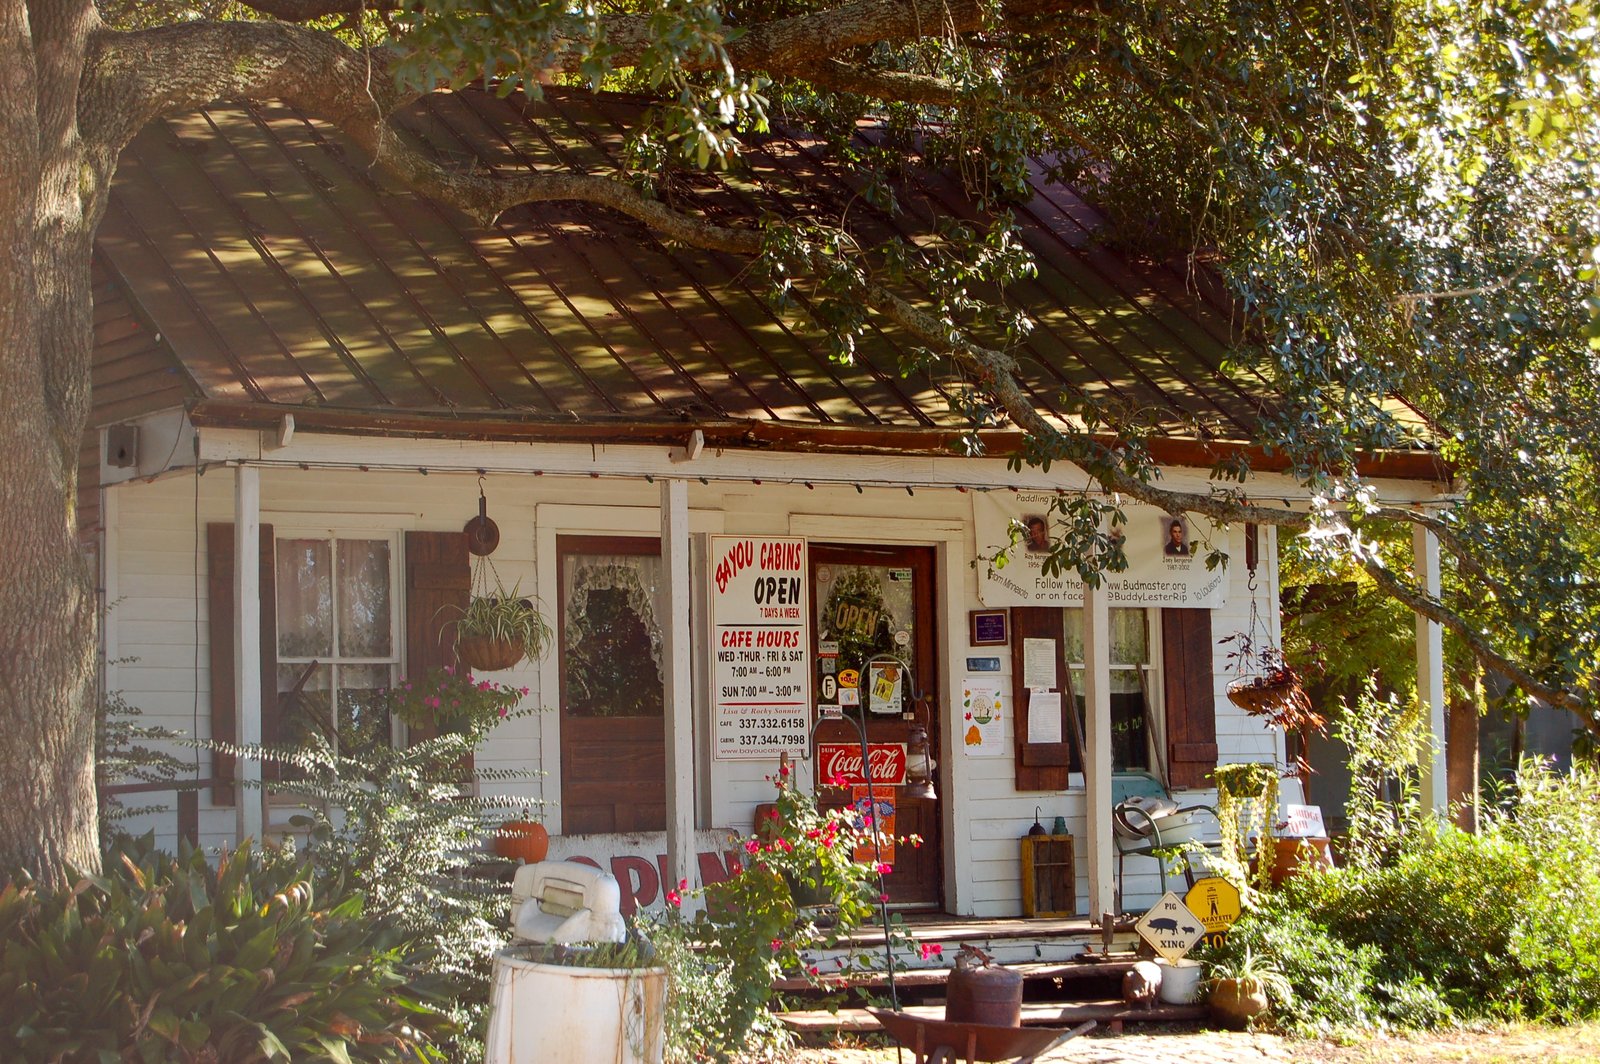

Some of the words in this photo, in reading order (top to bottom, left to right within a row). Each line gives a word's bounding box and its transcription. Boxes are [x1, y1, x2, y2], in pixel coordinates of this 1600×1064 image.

[1016, 494, 1049, 505] Paddling
[716, 540, 753, 594] BAYOU
[760, 542, 802, 571] CABINS
[1035, 578, 1061, 590] Follow
[754, 576, 801, 605] OPEN
[1062, 591, 1084, 600] face
[760, 608, 764, 618] 7
[764, 608, 778, 618] DAYS
[779, 608, 784, 618] A
[784, 608, 800, 618] WEEK
[836, 603, 878, 638] OPEN
[721, 630, 753, 647] CAFE
[756, 630, 800, 648] HOURS
[718, 651, 735, 662] WED
[767, 651, 779, 662] FRI
[781, 651, 787, 662] &
[789, 651, 804, 662] SAT
[731, 666, 748, 677] 7:00
[749, 666, 758, 674] AM
[765, 666, 782, 677] 6:00
[783, 666, 791, 674] PM
[722, 686, 739, 697] SUN
[740, 686, 757, 697] 7:00
[775, 686, 792, 697] 3:00
[750, 707, 772, 716] Rocky
[774, 707, 802, 715] Sonnier
[739, 718, 805, 729] 337.332.6158
[739, 735, 805, 746] 337.344.7998
[1201, 914, 1232, 923] AFAYETTE
[1160, 940, 1185, 949] XING
